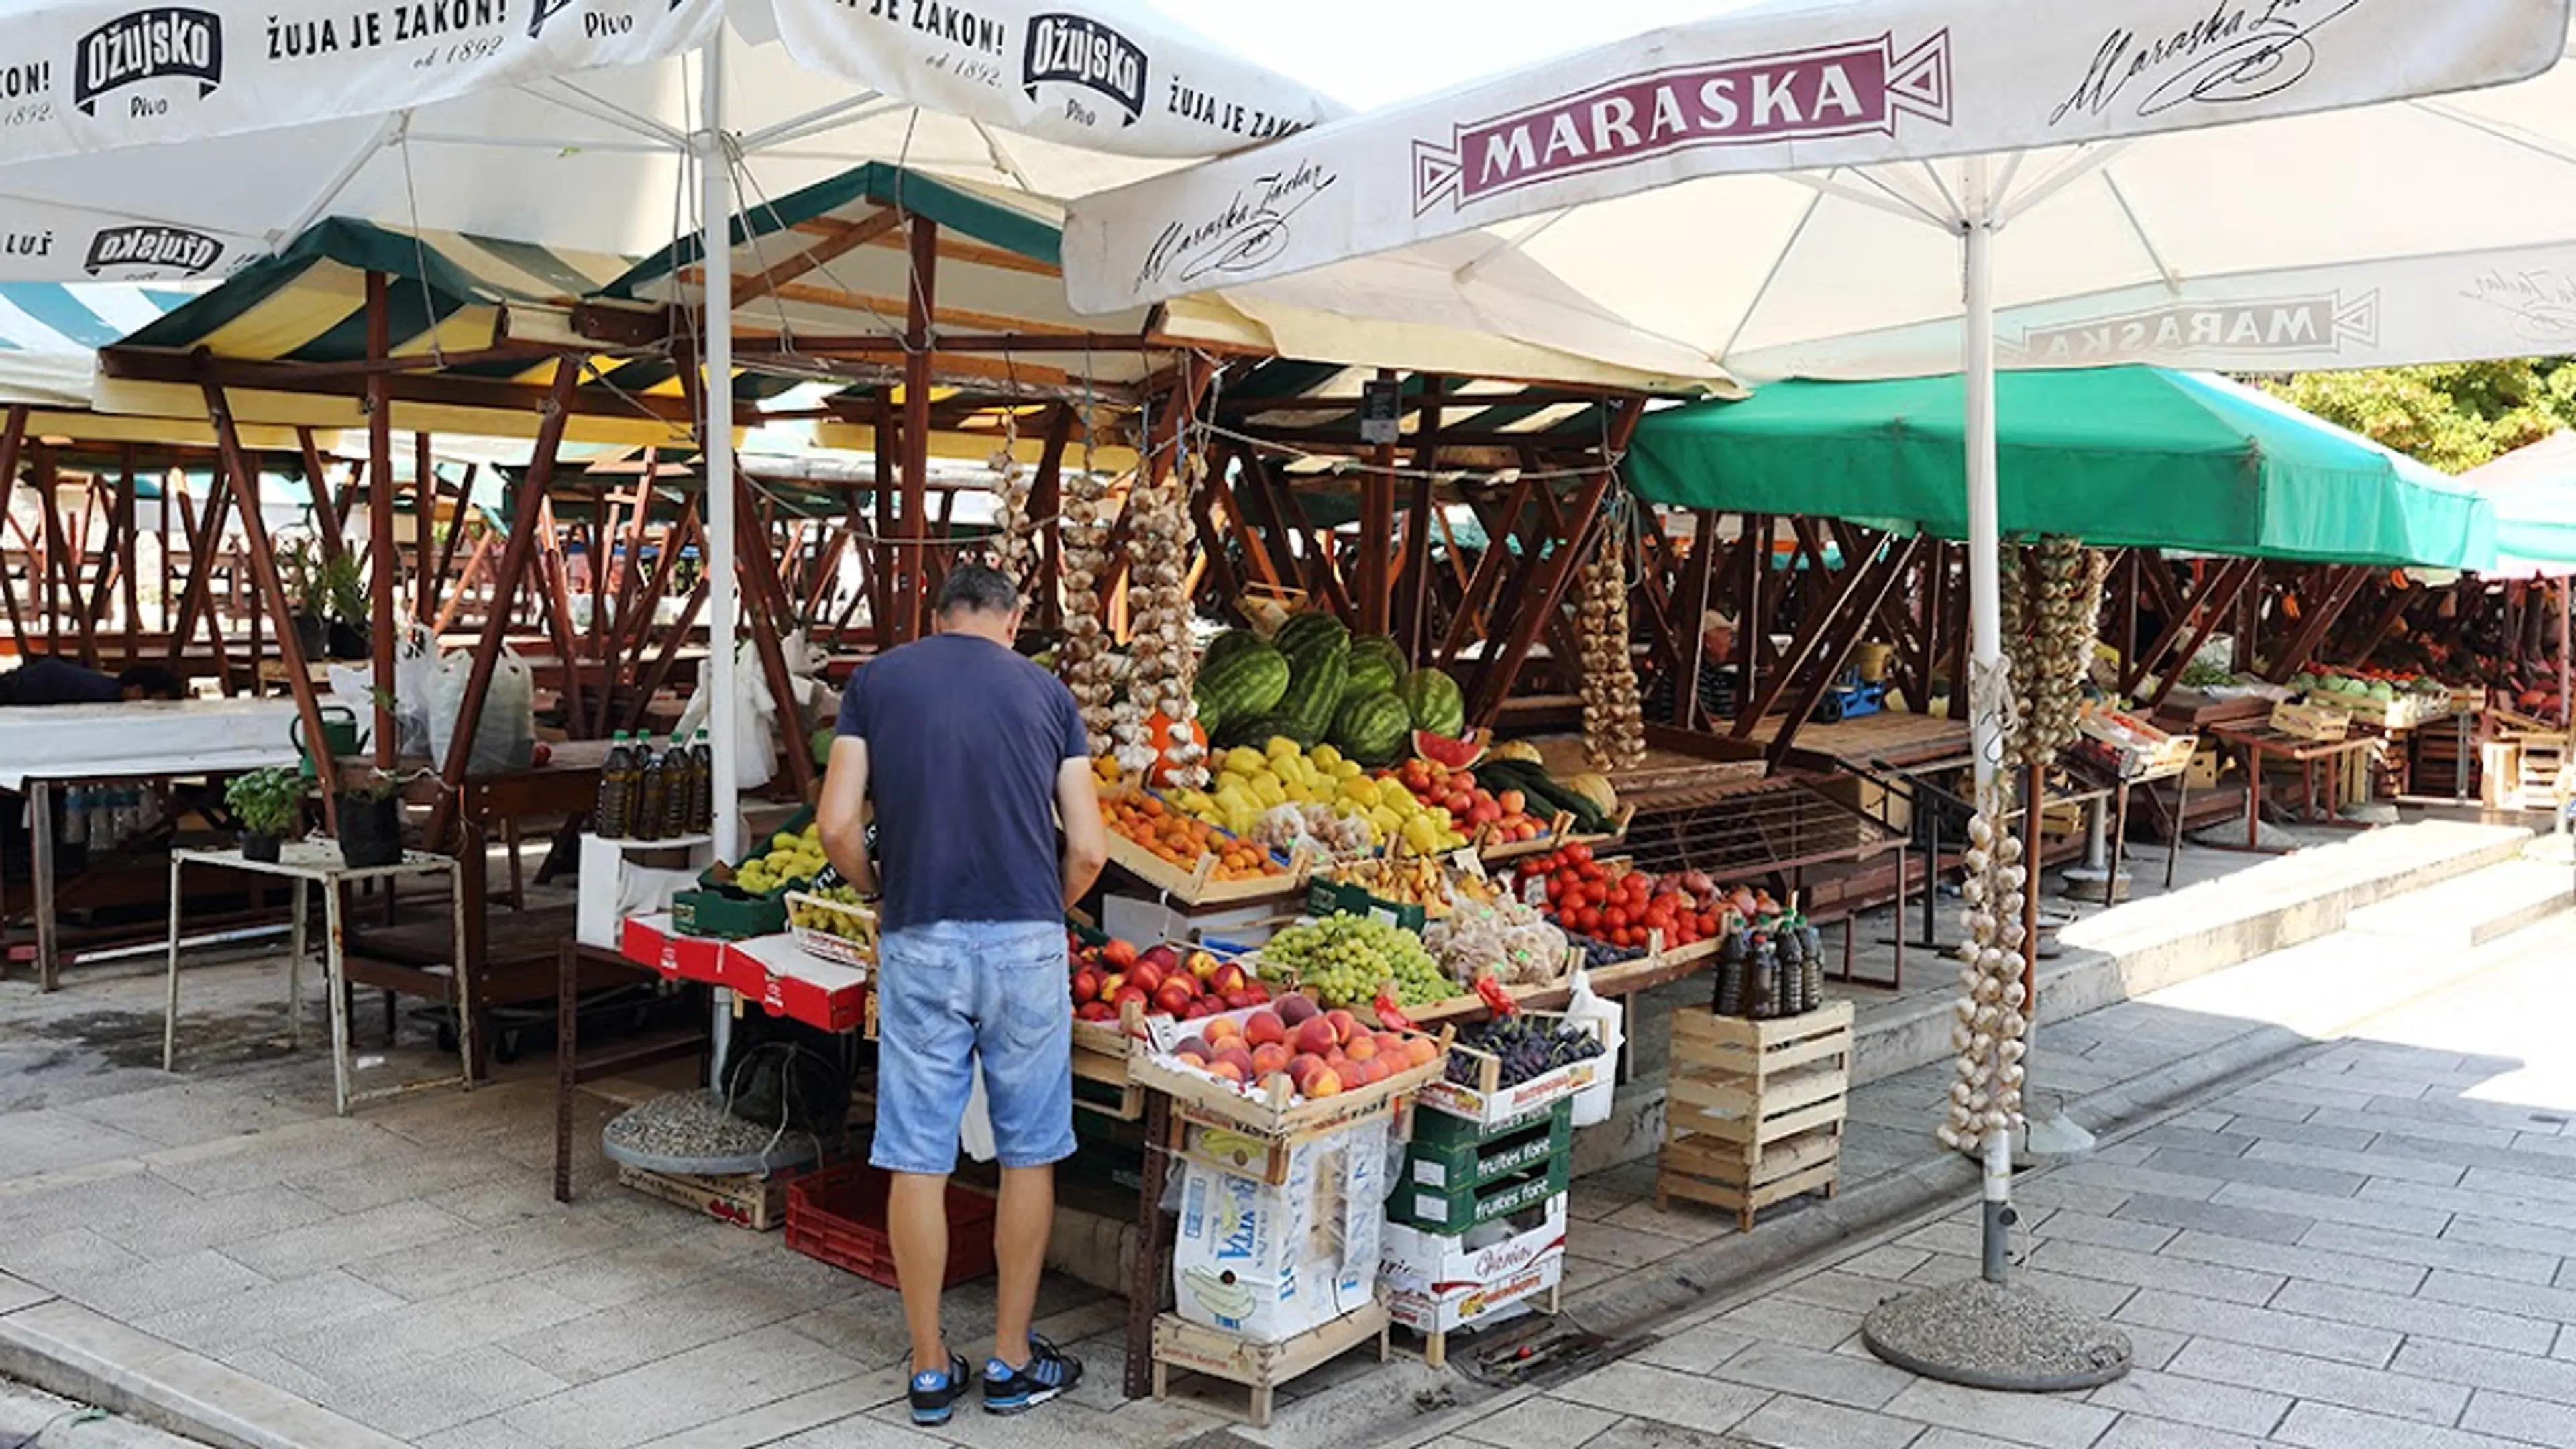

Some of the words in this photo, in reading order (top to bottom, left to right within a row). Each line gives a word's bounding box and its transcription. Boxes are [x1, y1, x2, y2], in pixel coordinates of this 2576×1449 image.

[88, 11, 210, 90] Ožujsko
[267, 15, 338, 59] ŽUJA
[350, 12, 382, 49] JE
[394, 0, 506, 41] ZAKON!
[585, 12, 633, 38] Pivo
[912, 0, 1004, 56] ZAKON!
[0, 60, 51, 98] ON!
[1033, 18, 1138, 99] Ožujsko
[130, 95, 168, 118] Pivo
[1168, 74, 1216, 125] ŽUJA
[1222, 103, 1246, 133] JE
[1479, 64, 1864, 184] MARASKA
